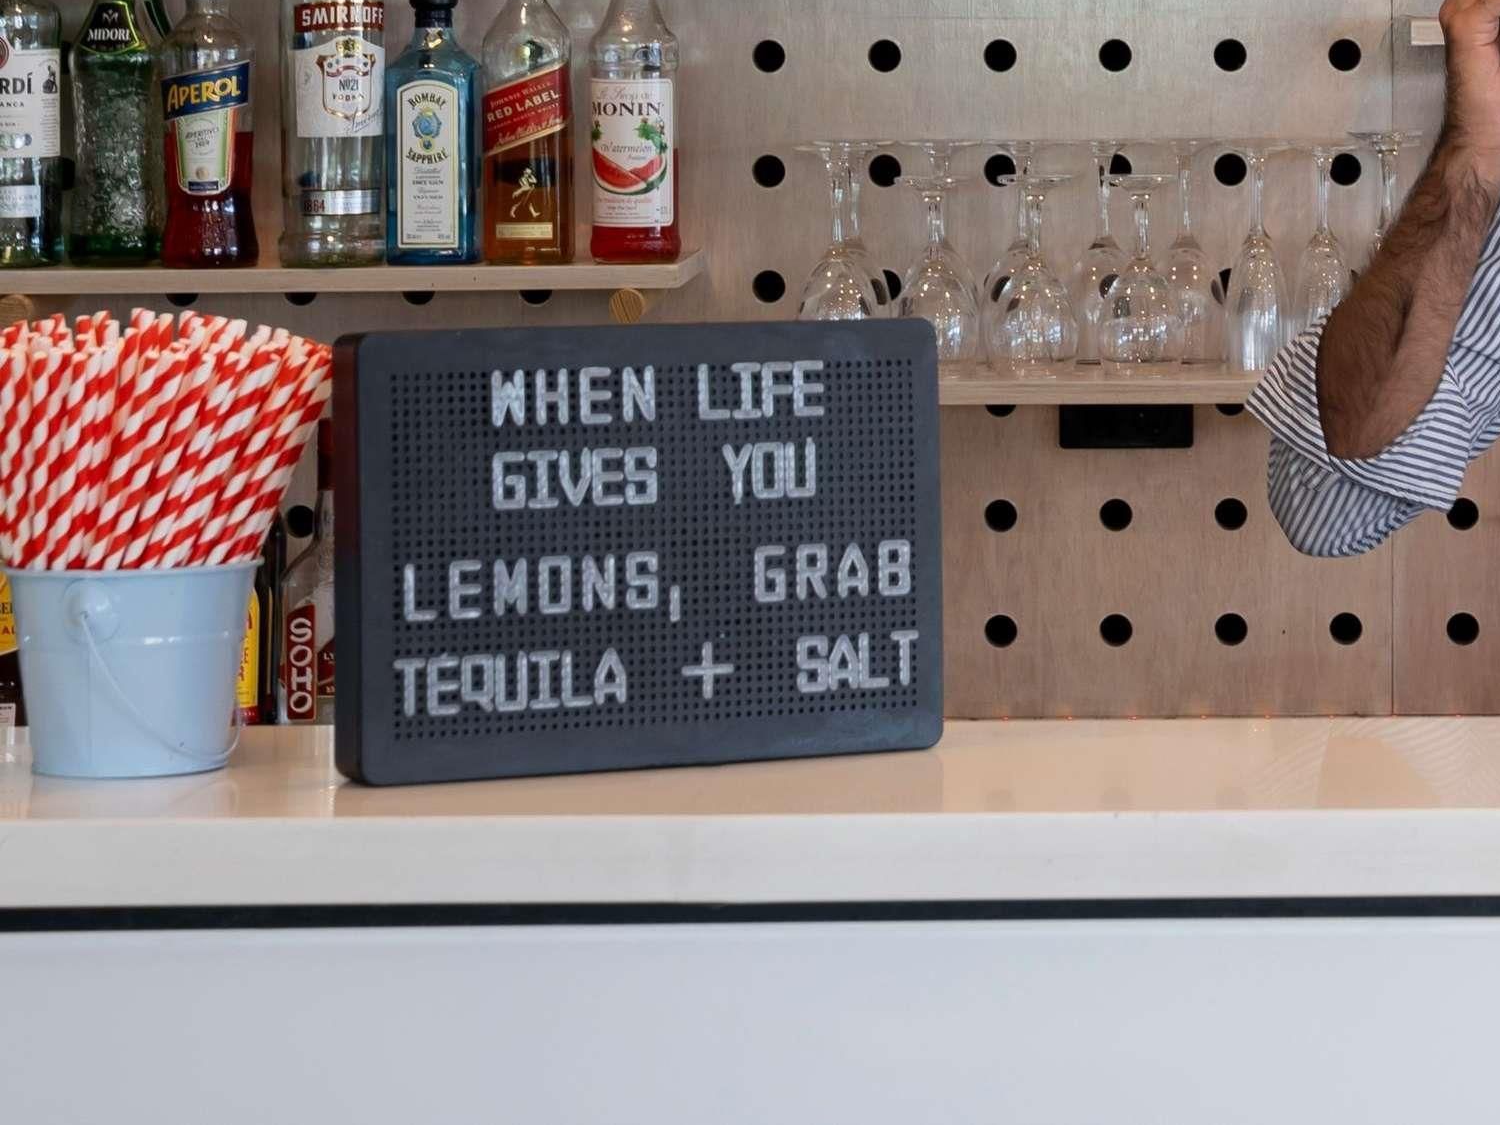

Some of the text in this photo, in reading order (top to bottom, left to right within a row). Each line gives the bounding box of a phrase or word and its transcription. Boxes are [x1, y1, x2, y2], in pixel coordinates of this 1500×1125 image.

[301, 5, 384, 27] SMIRNOFF
[87, 28, 131, 42] MIDORI
[167, 75, 241, 113] APEROL
[407, 92, 448, 110] BOMBAY
[486, 90, 561, 123] RED LABEL
[590, 101, 661, 117] MONIN
[405, 146, 450, 165] SAPPHIRE
[491, 359, 826, 428] WHEN LIFE
[491, 436, 818, 511] GIVES YOU
[402, 539, 912, 623] LEMONS, GRAB
[289, 616, 313, 714] SOHO
[393, 629, 920, 718] TEQUILA + SALT
